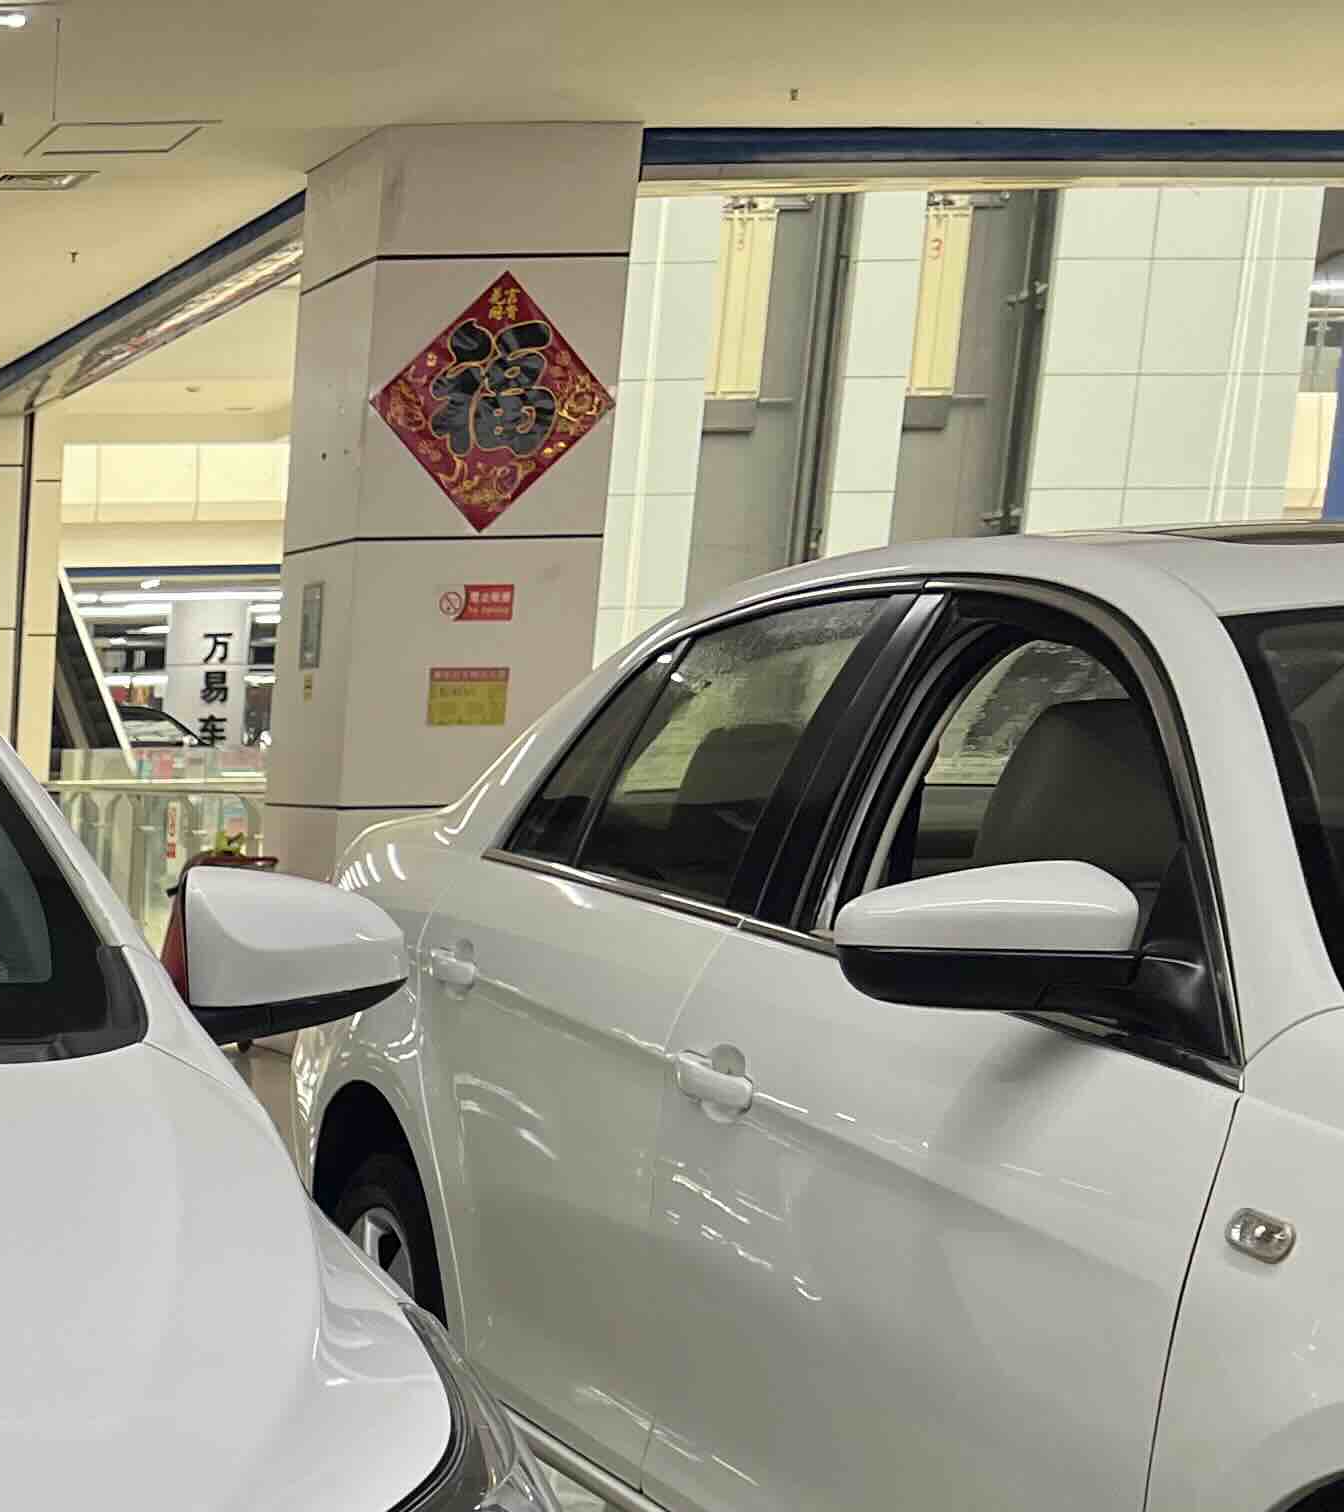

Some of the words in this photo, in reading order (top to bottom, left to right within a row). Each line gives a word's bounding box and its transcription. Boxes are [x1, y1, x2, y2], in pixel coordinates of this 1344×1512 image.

[429, 317, 559, 459] 福
[198, 632, 233, 746] 万易车
